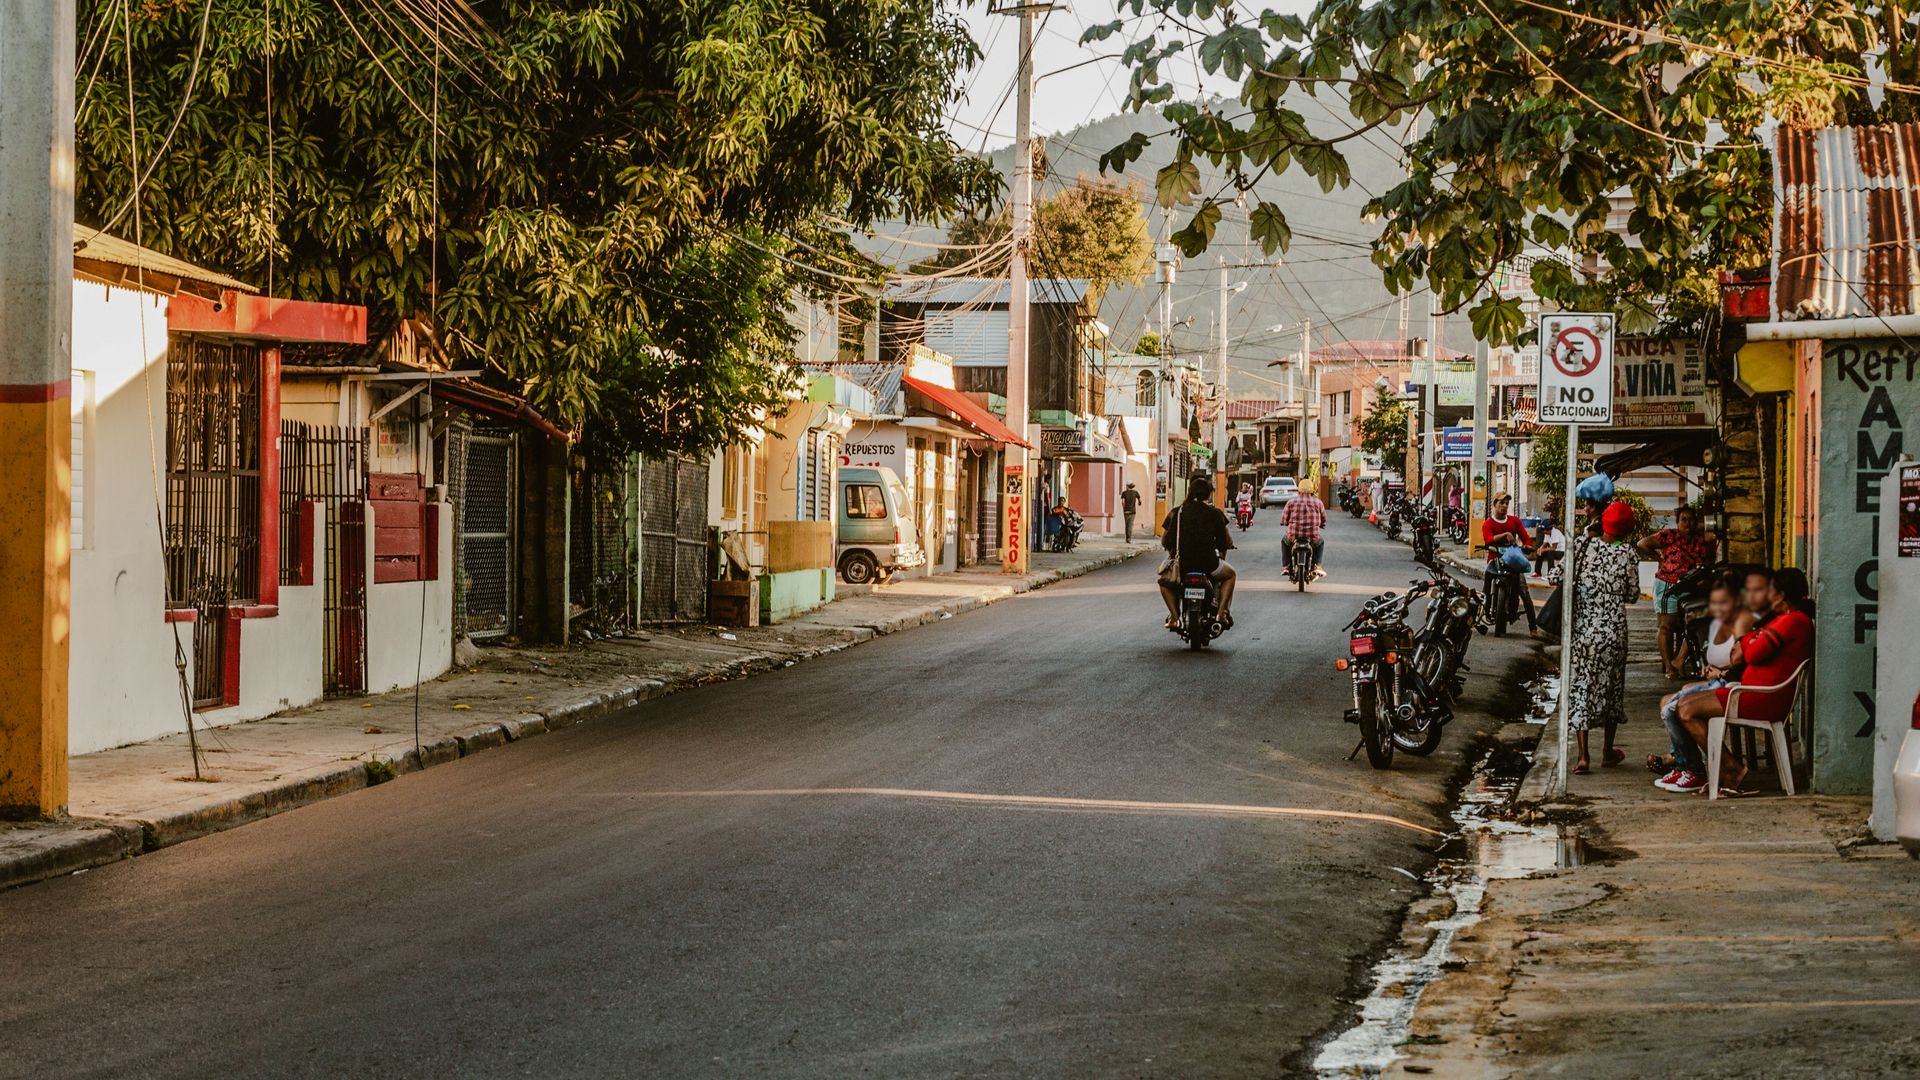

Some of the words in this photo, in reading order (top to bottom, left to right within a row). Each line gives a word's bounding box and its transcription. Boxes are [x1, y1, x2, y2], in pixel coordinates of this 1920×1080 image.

[1560, 387, 1594, 404] NO
[1542, 405, 1608, 417] ESTACIONAR
[1625, 414, 1663, 426] TEMPRANO
[845, 443, 896, 456] REPUESTOS
